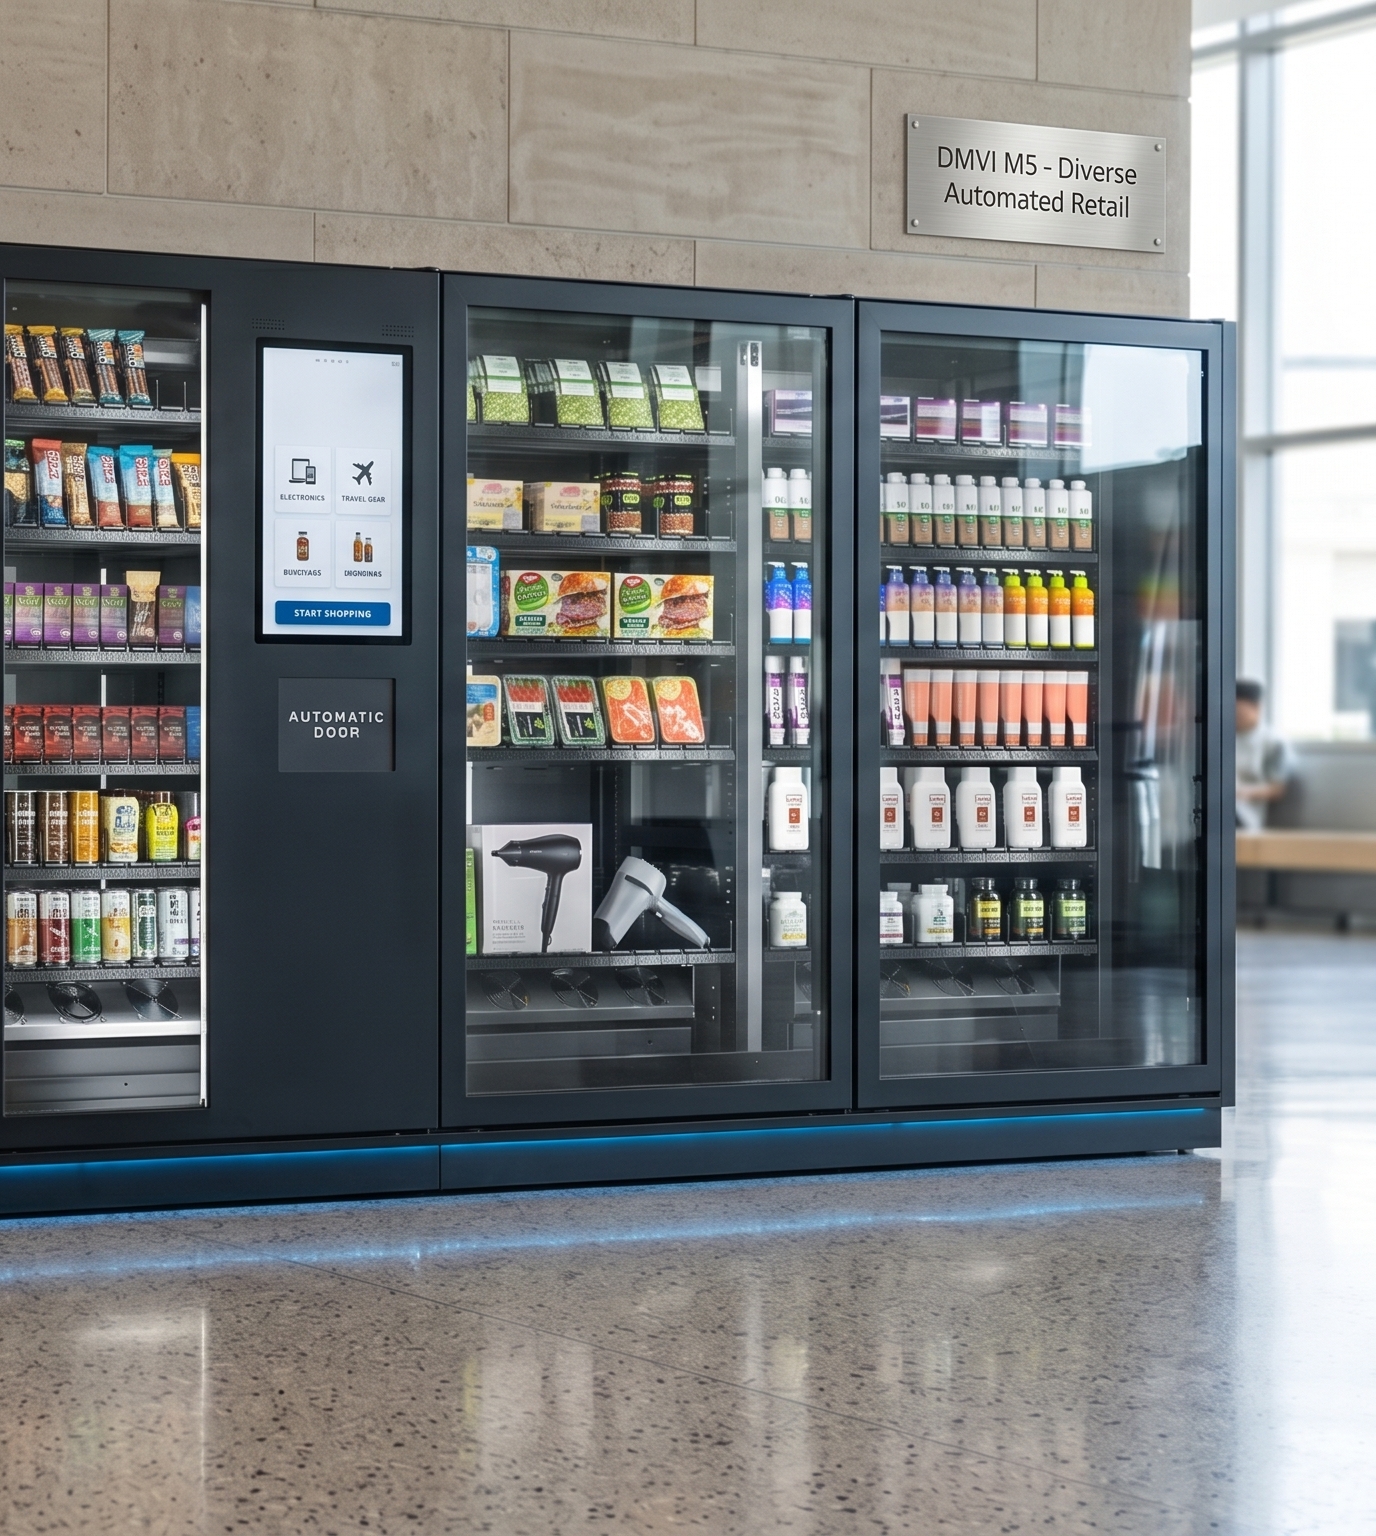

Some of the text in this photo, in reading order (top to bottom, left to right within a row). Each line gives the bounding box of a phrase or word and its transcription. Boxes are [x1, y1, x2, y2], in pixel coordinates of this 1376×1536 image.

[937, 145, 996, 173] DMVI
[1004, 151, 1038, 176] M5
[1058, 156, 1138, 185] Diverse
[943, 181, 1130, 219] Automated Retail
[280, 493, 325, 502] ELECTRONICS
[341, 495, 367, 503] TRAVEL
[294, 608, 372, 619] START SHOPPING
[288, 711, 384, 723] AUTOMATIC
[314, 726, 360, 739] DOOR
